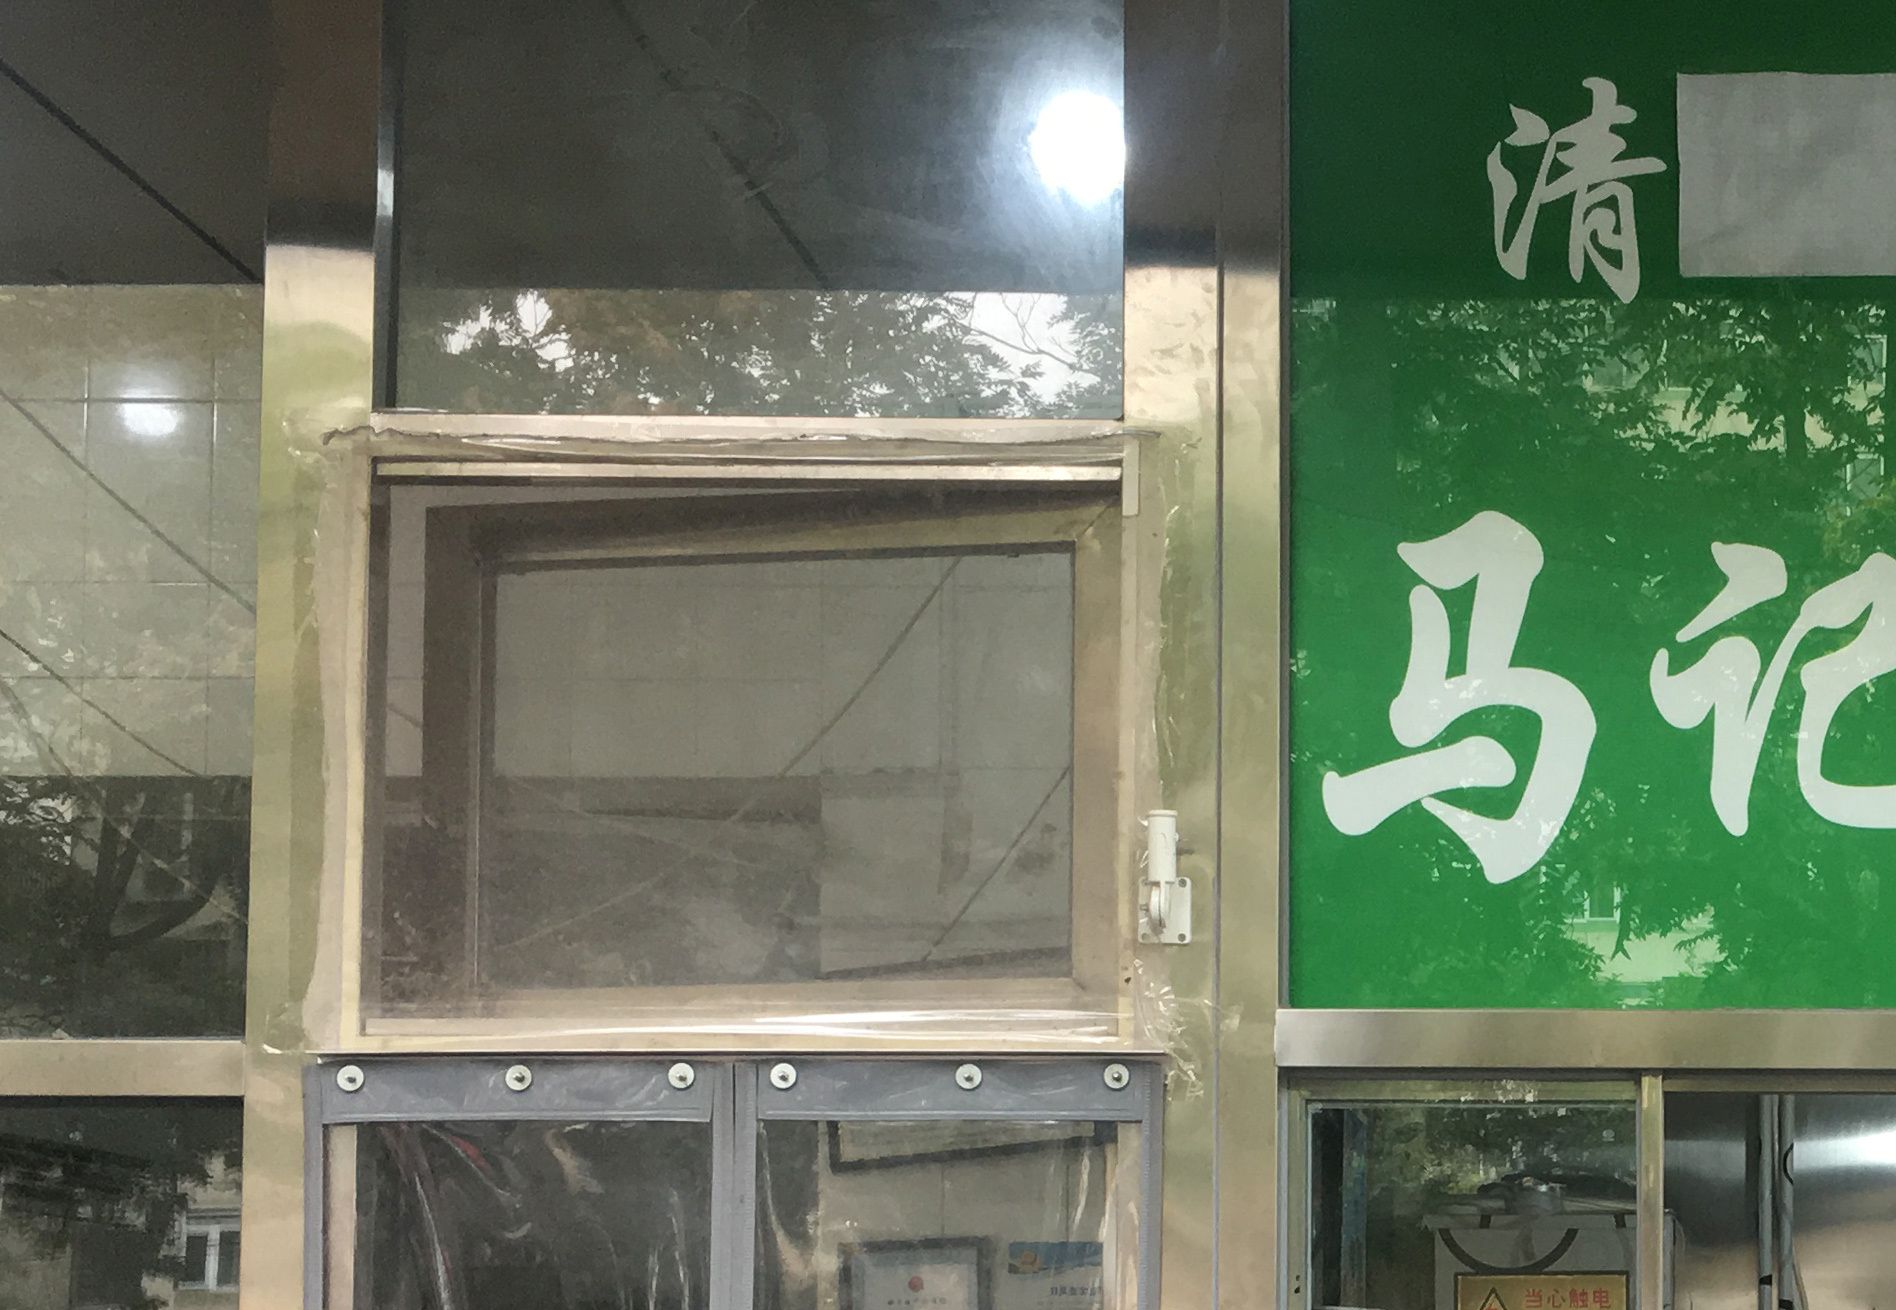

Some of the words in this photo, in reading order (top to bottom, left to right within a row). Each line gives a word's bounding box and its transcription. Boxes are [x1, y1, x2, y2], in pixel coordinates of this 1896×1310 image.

[1486, 77, 1667, 304] 清
[1525, 1288, 1611, 1309] 当心触电
